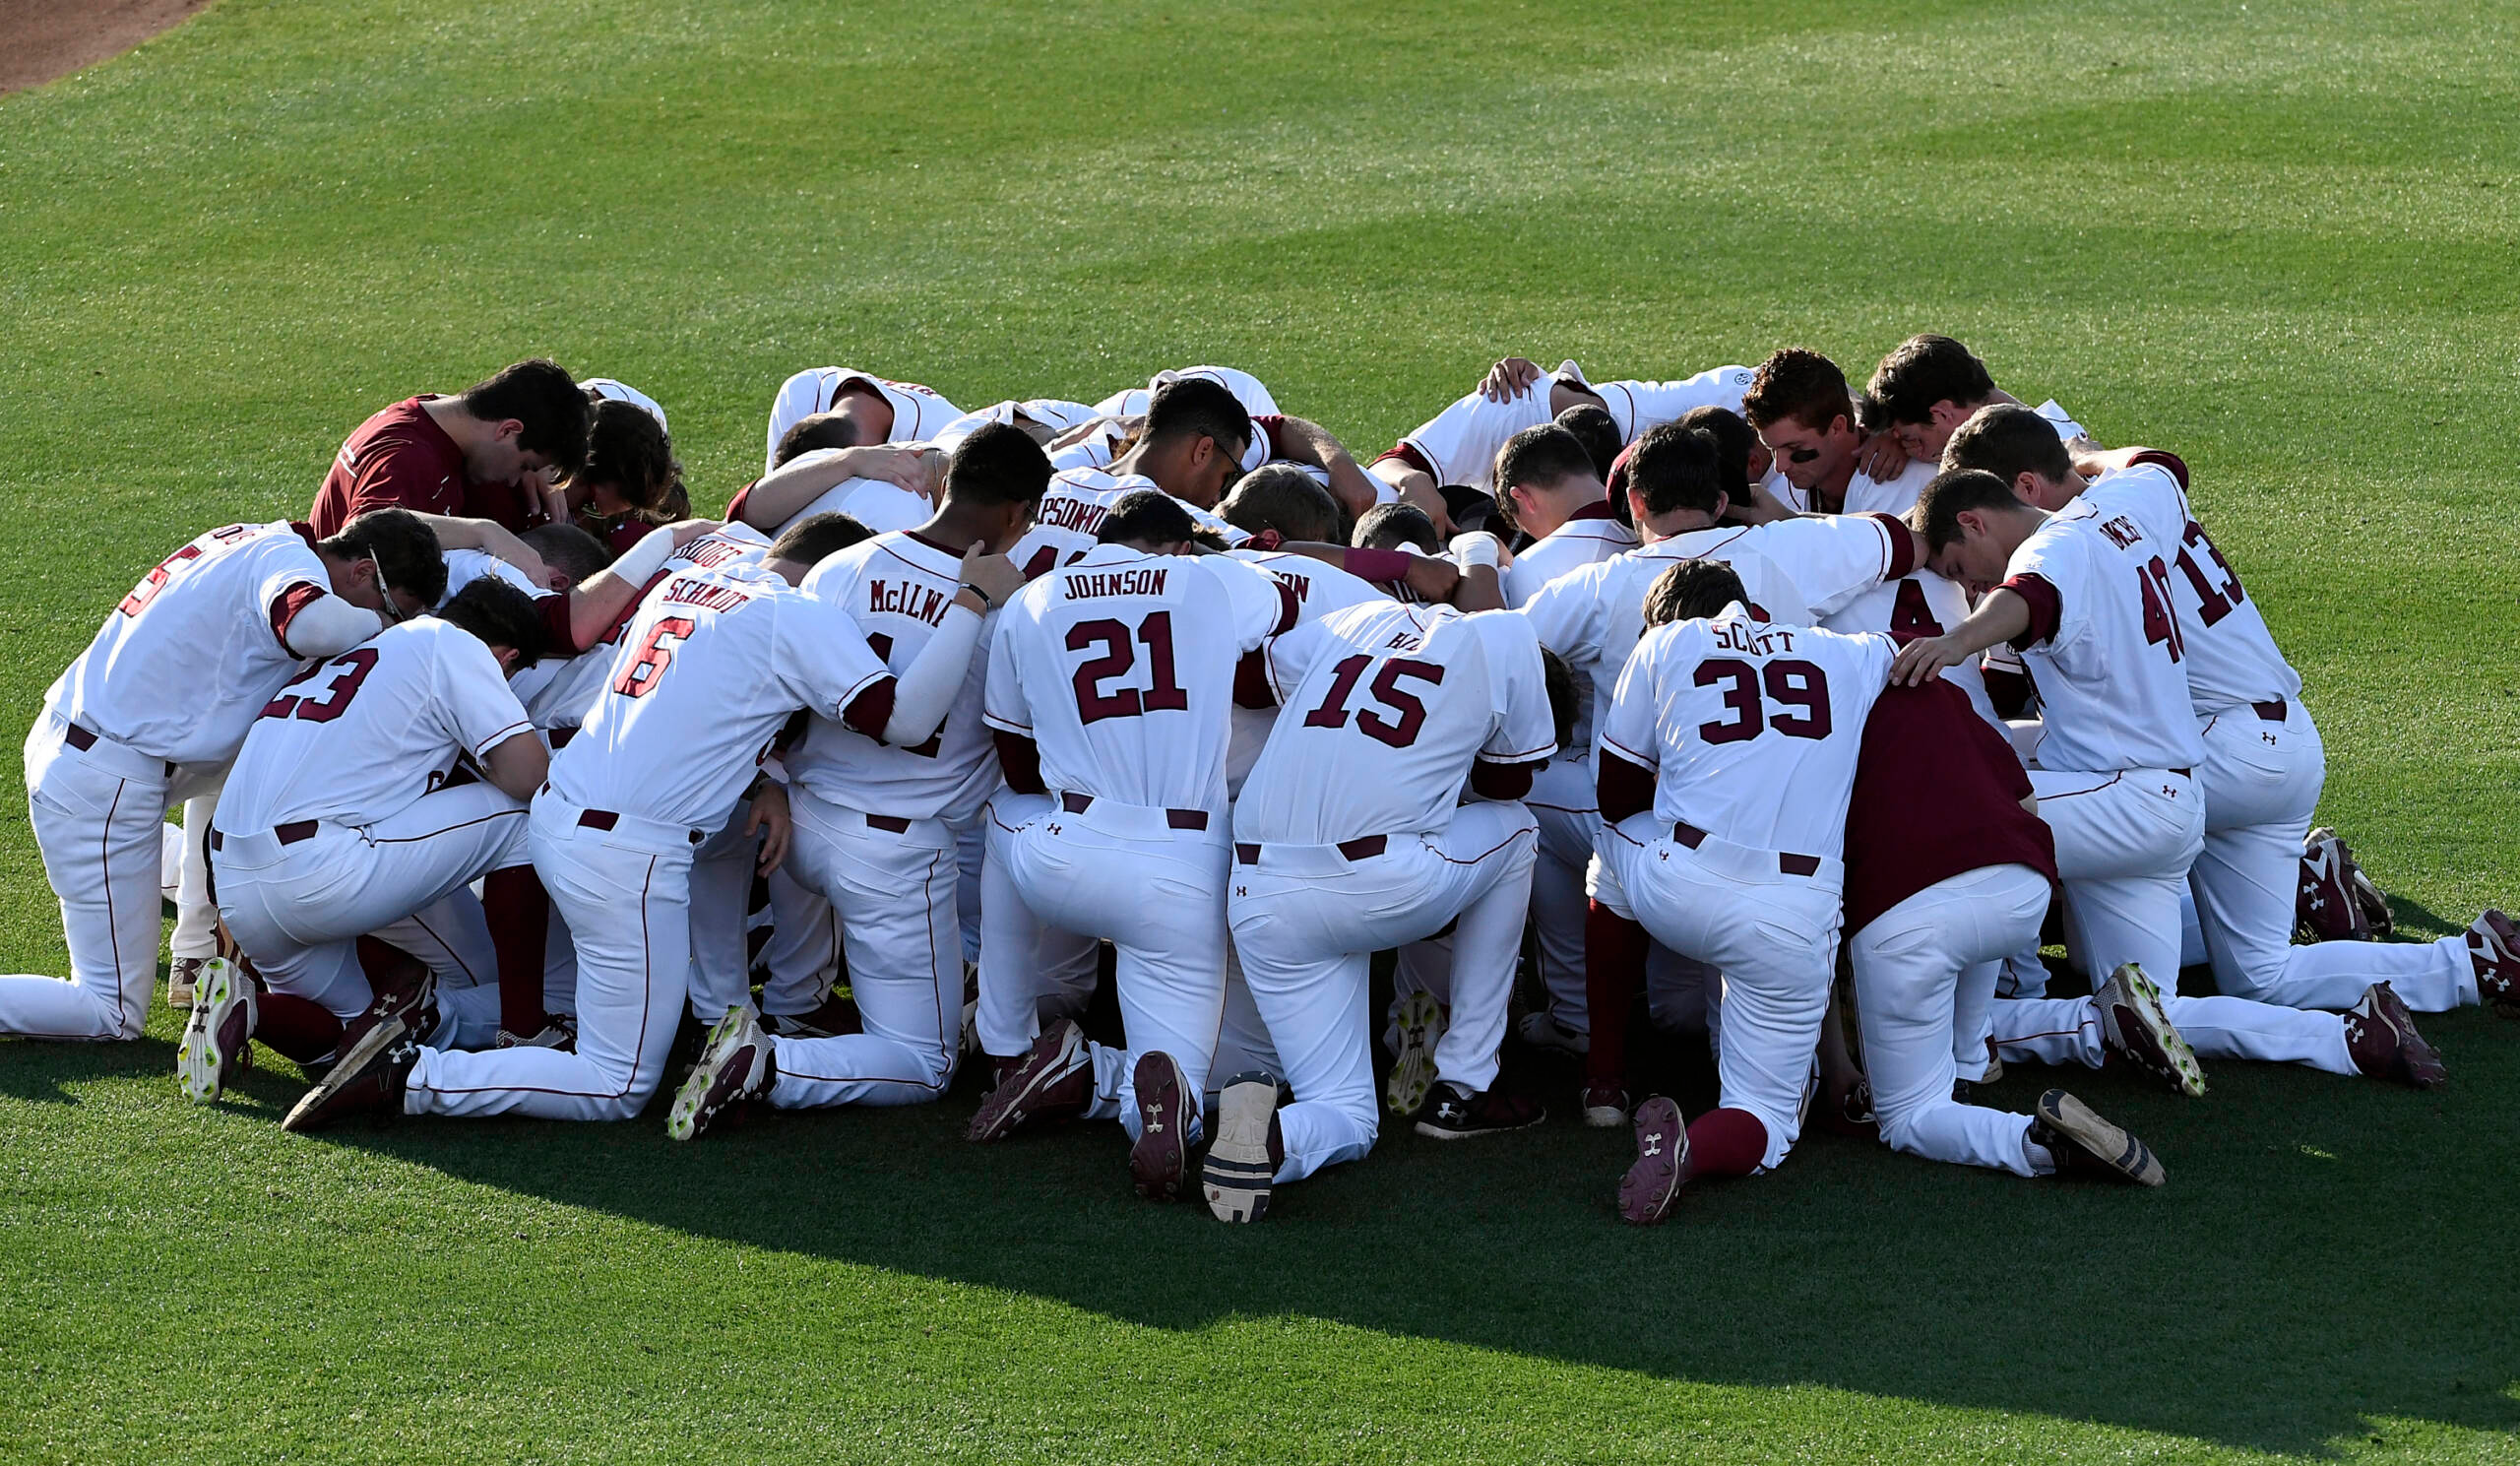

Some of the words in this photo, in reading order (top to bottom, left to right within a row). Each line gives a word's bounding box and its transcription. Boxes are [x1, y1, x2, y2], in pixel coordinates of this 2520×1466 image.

[662, 577, 750, 614] SCHMIDT
[1064, 568, 1168, 601] JOHNSON
[2172, 519, 2245, 629] 13
[252, 647, 380, 724] 23
[612, 615, 696, 699] 6
[1064, 609, 1189, 727] 21
[1302, 653, 1445, 749] 15
[1692, 658, 1833, 746] 39
